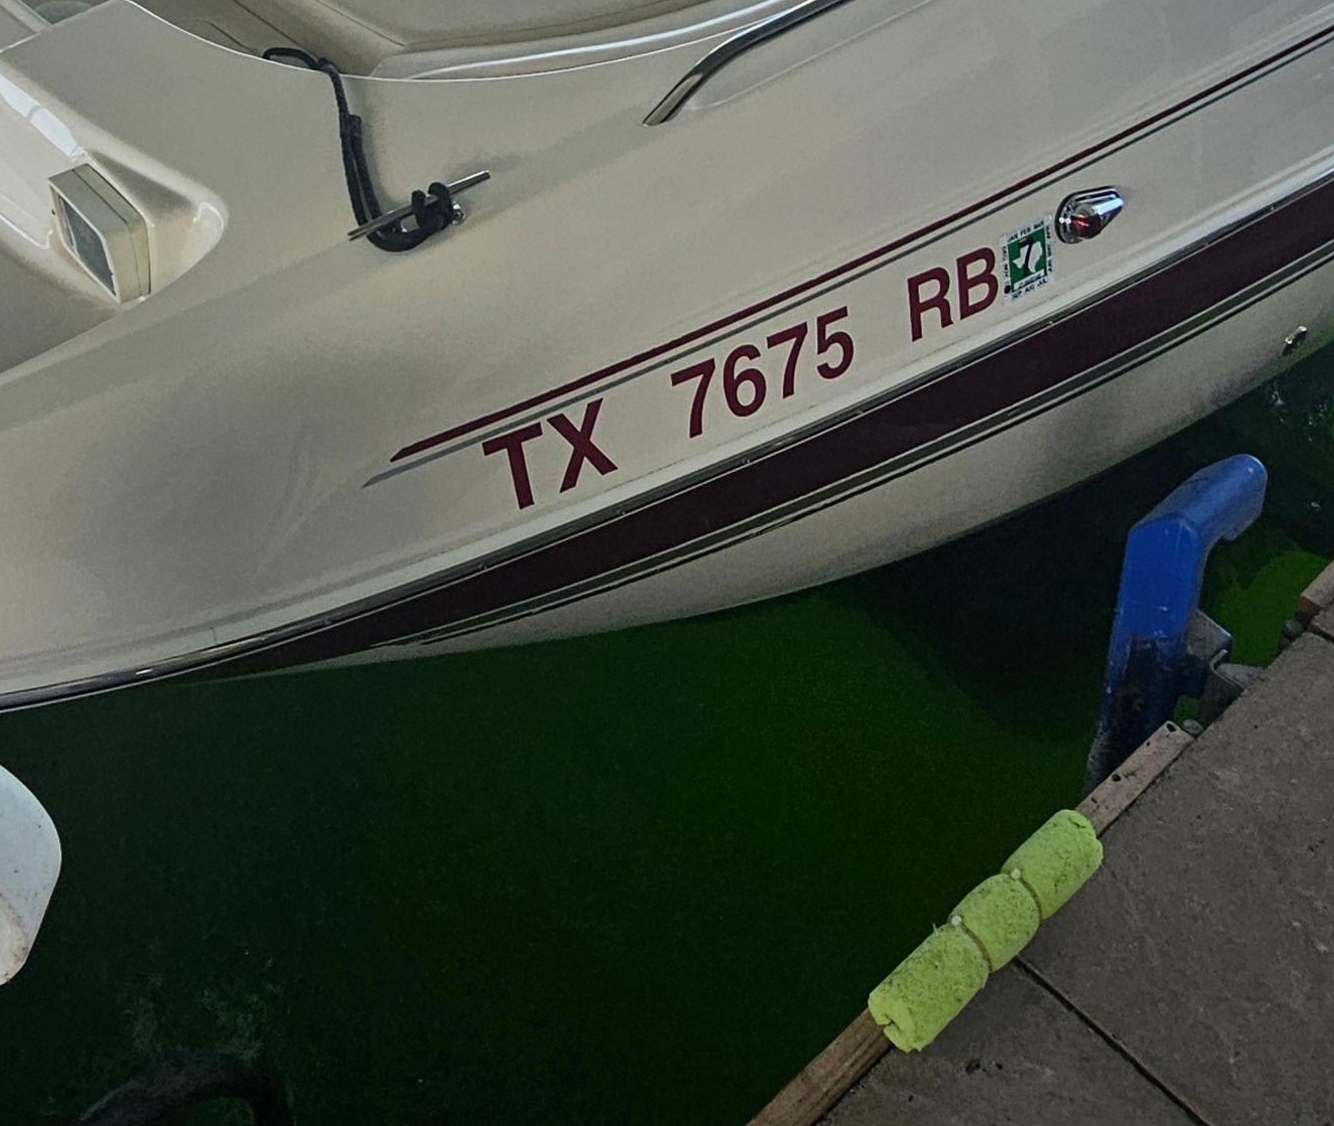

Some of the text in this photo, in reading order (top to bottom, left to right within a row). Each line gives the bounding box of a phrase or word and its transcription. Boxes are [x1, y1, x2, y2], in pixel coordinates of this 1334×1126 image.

[481, 398, 618, 510] TX
[670, 305, 854, 438] 7675
[907, 247, 999, 342] RB
